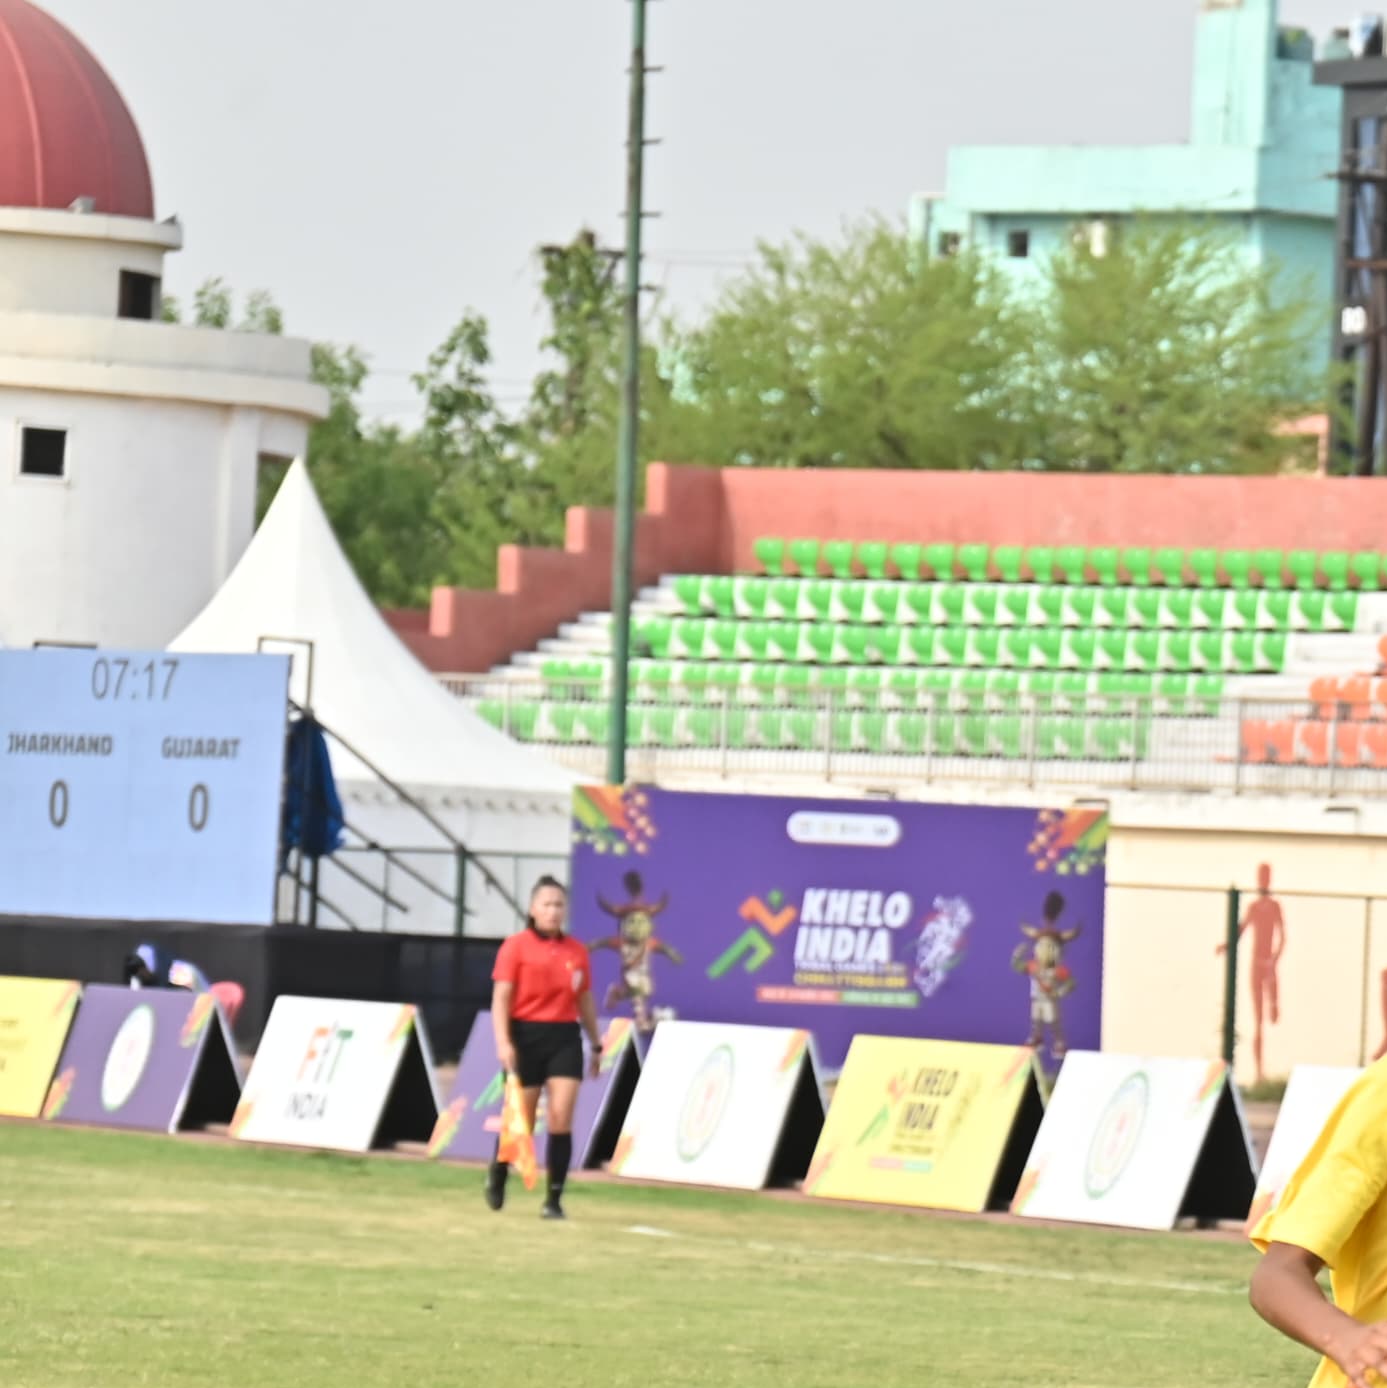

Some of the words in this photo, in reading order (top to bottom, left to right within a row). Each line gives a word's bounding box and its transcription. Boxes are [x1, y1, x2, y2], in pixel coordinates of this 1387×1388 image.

[92, 657, 179, 700] 07:17
[8, 733, 114, 756] JHARKHAND
[161, 736, 240, 759] GUJARAT
[49, 779, 69, 829] 0
[188, 782, 208, 832] 0
[801, 887, 912, 928] KHELO
[795, 925, 892, 962] INDIA
[911, 1066, 959, 1097] KHELO
[899, 1101, 940, 1130] INDIA
